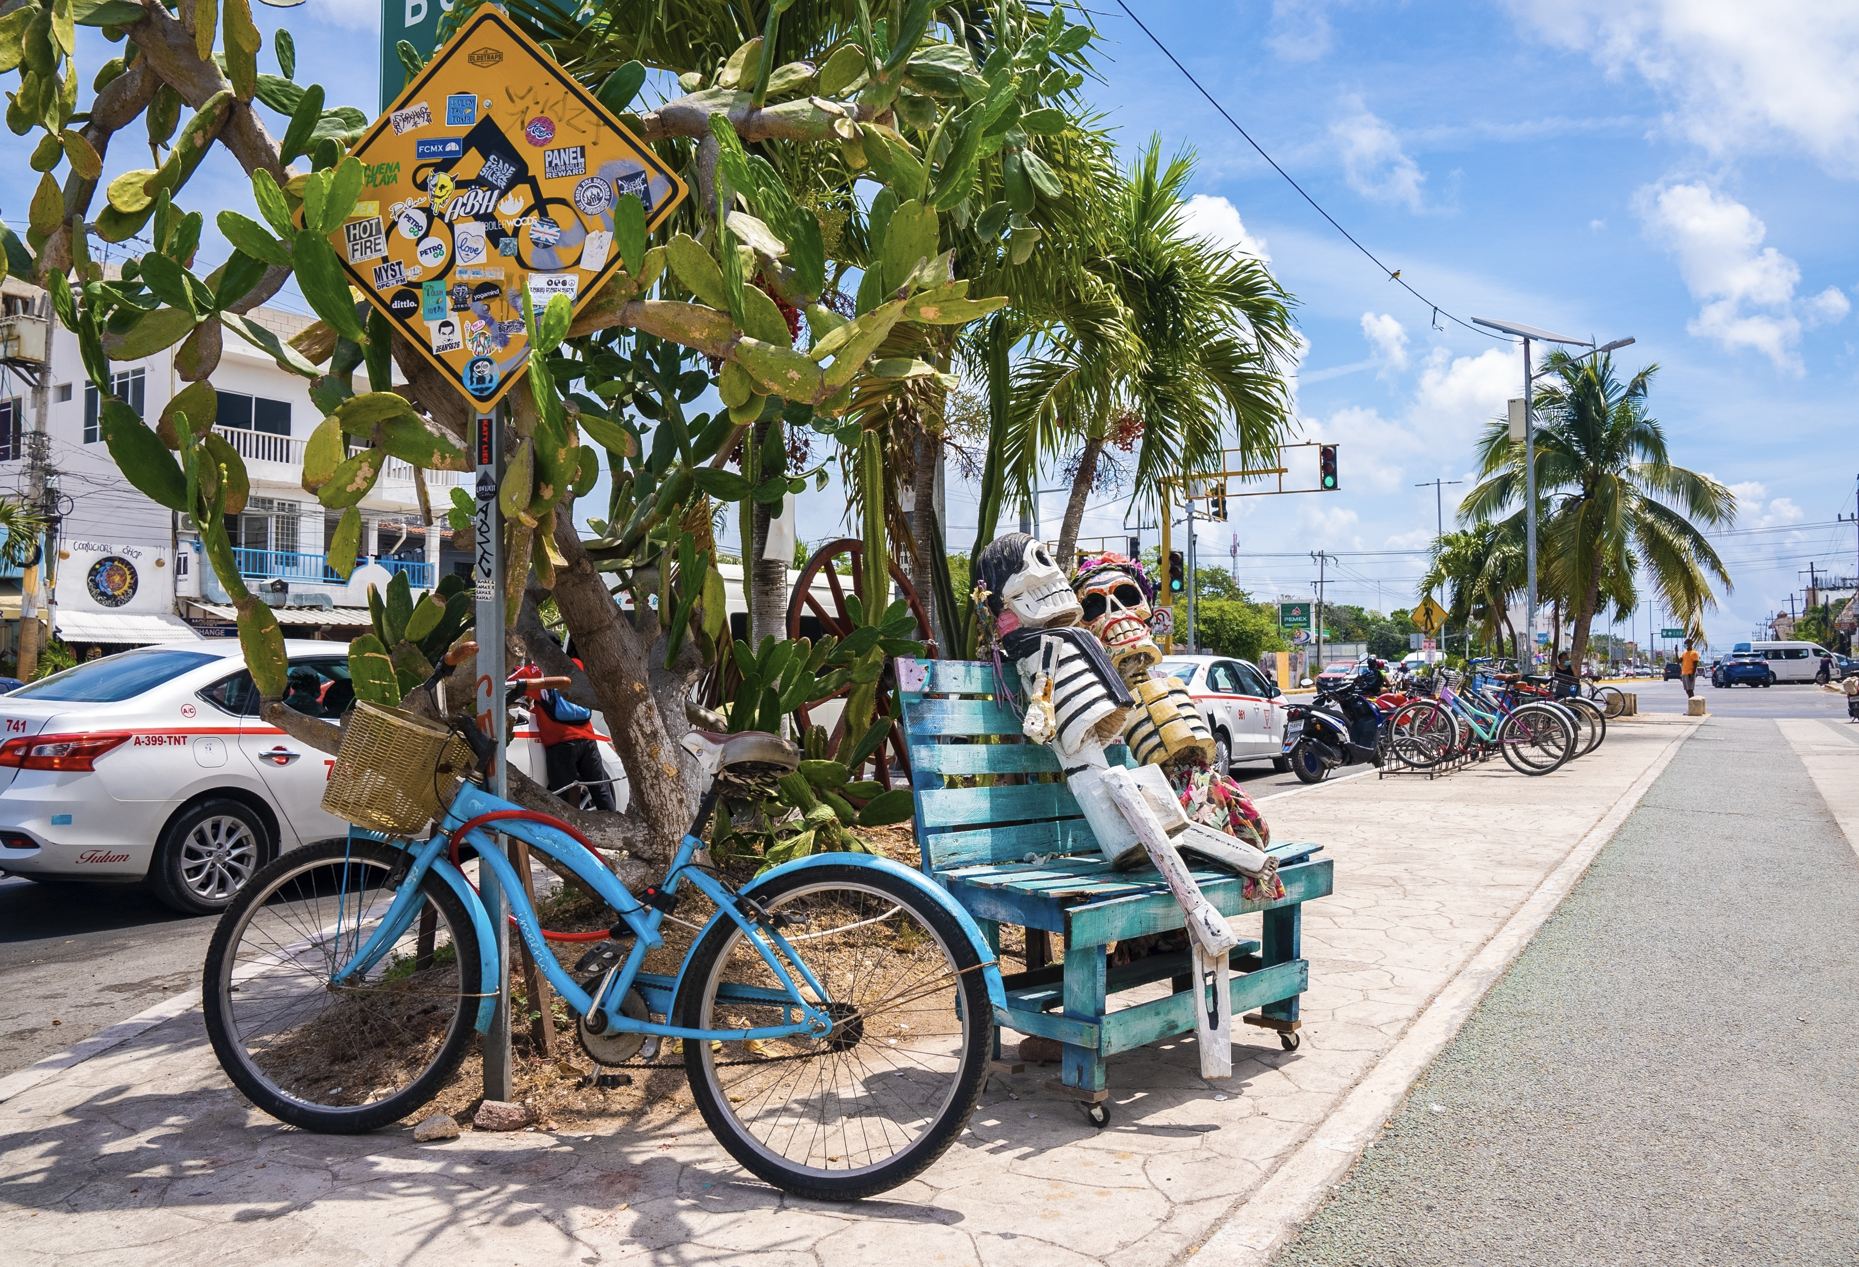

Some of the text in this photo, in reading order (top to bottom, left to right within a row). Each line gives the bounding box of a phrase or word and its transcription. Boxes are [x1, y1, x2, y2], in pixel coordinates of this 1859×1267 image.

[418, 145, 443, 153] FCMX
[545, 146, 585, 168] PANEL
[489, 155, 516, 176] CASE
[546, 168, 586, 179] REWARD
[444, 188, 501, 224] ABH
[403, 213, 424, 232] PETRO
[349, 218, 379, 242] HOT
[408, 226, 419, 237] GO
[351, 236, 383, 259] FIRE
[420, 243, 443, 257] PETRO
[459, 237, 480, 255] love
[432, 249, 445, 259] GO
[373, 260, 404, 283] MYST
[474, 288, 500, 301] yogamind
[391, 300, 418, 309] dittlo.
[198, 627, 226, 637] HANGE
[6, 719, 27, 733] 741
[133, 735, 188, 747] A-399-TNT
[75, 849, 131, 865] Tulum
